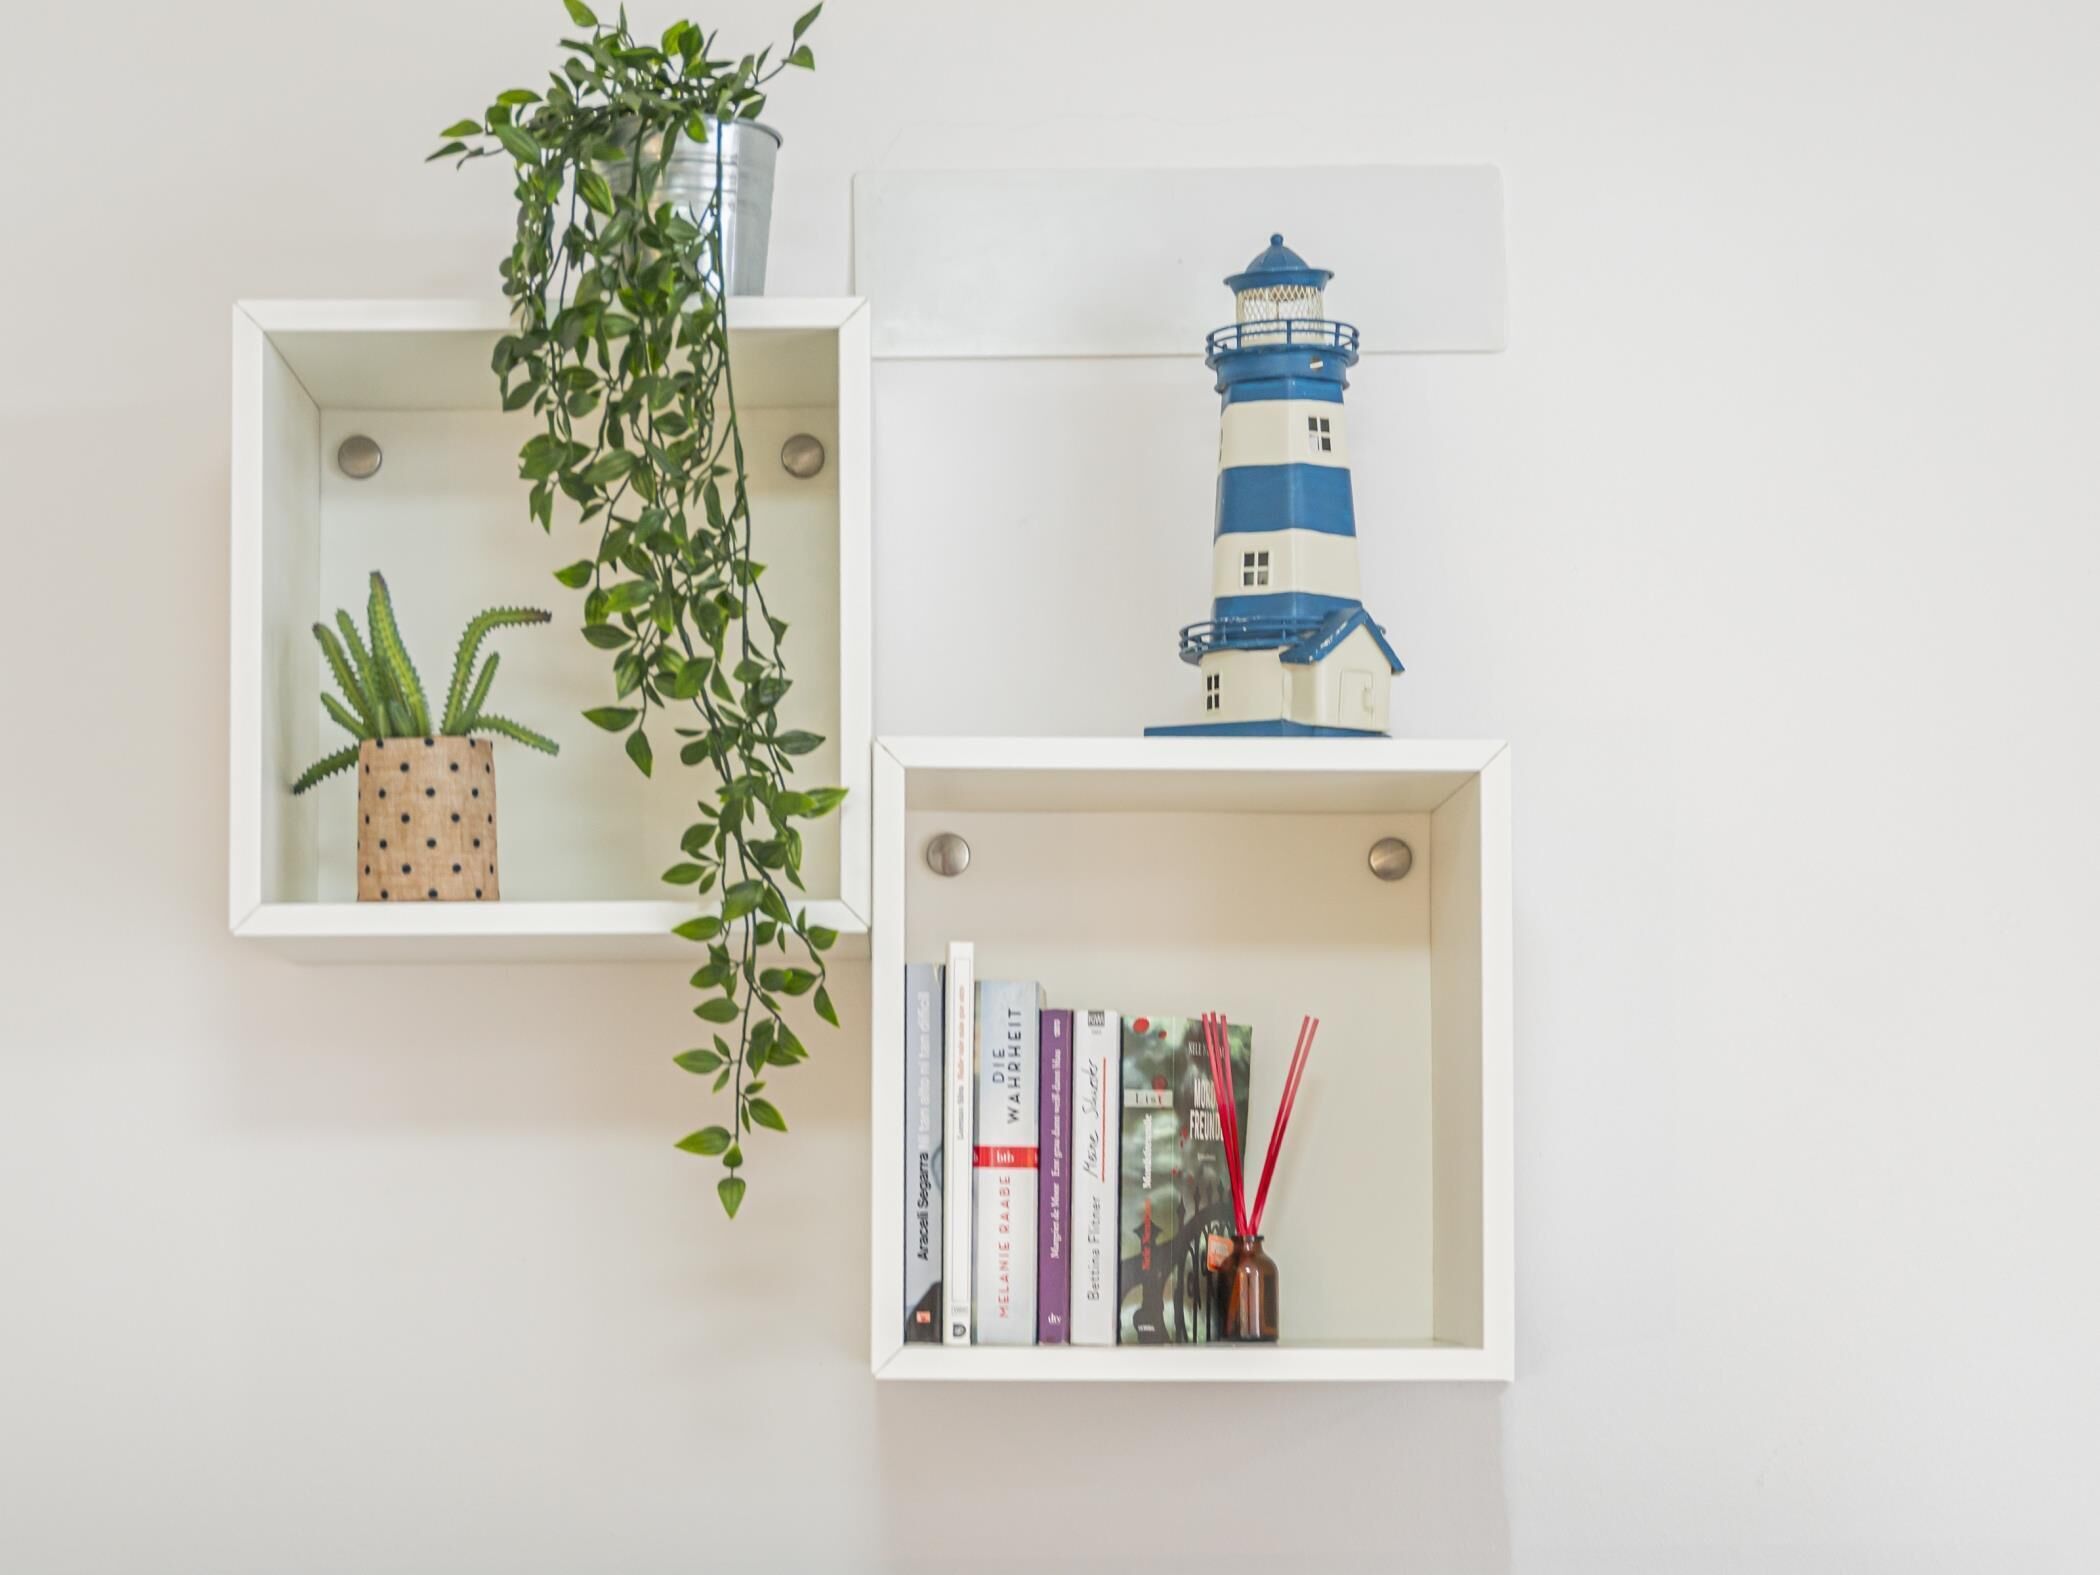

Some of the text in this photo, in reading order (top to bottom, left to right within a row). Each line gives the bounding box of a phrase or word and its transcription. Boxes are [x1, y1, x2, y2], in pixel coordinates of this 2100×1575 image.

[991, 1046, 1006, 1083] DIE
[1007, 1007, 1022, 1124] WAHRHEIT
[917, 1152, 931, 1262] Araceli Segarra
[997, 1175, 1011, 1319] MELANIE RAABE
[1086, 1193, 1100, 1301] Bettina Flitner
